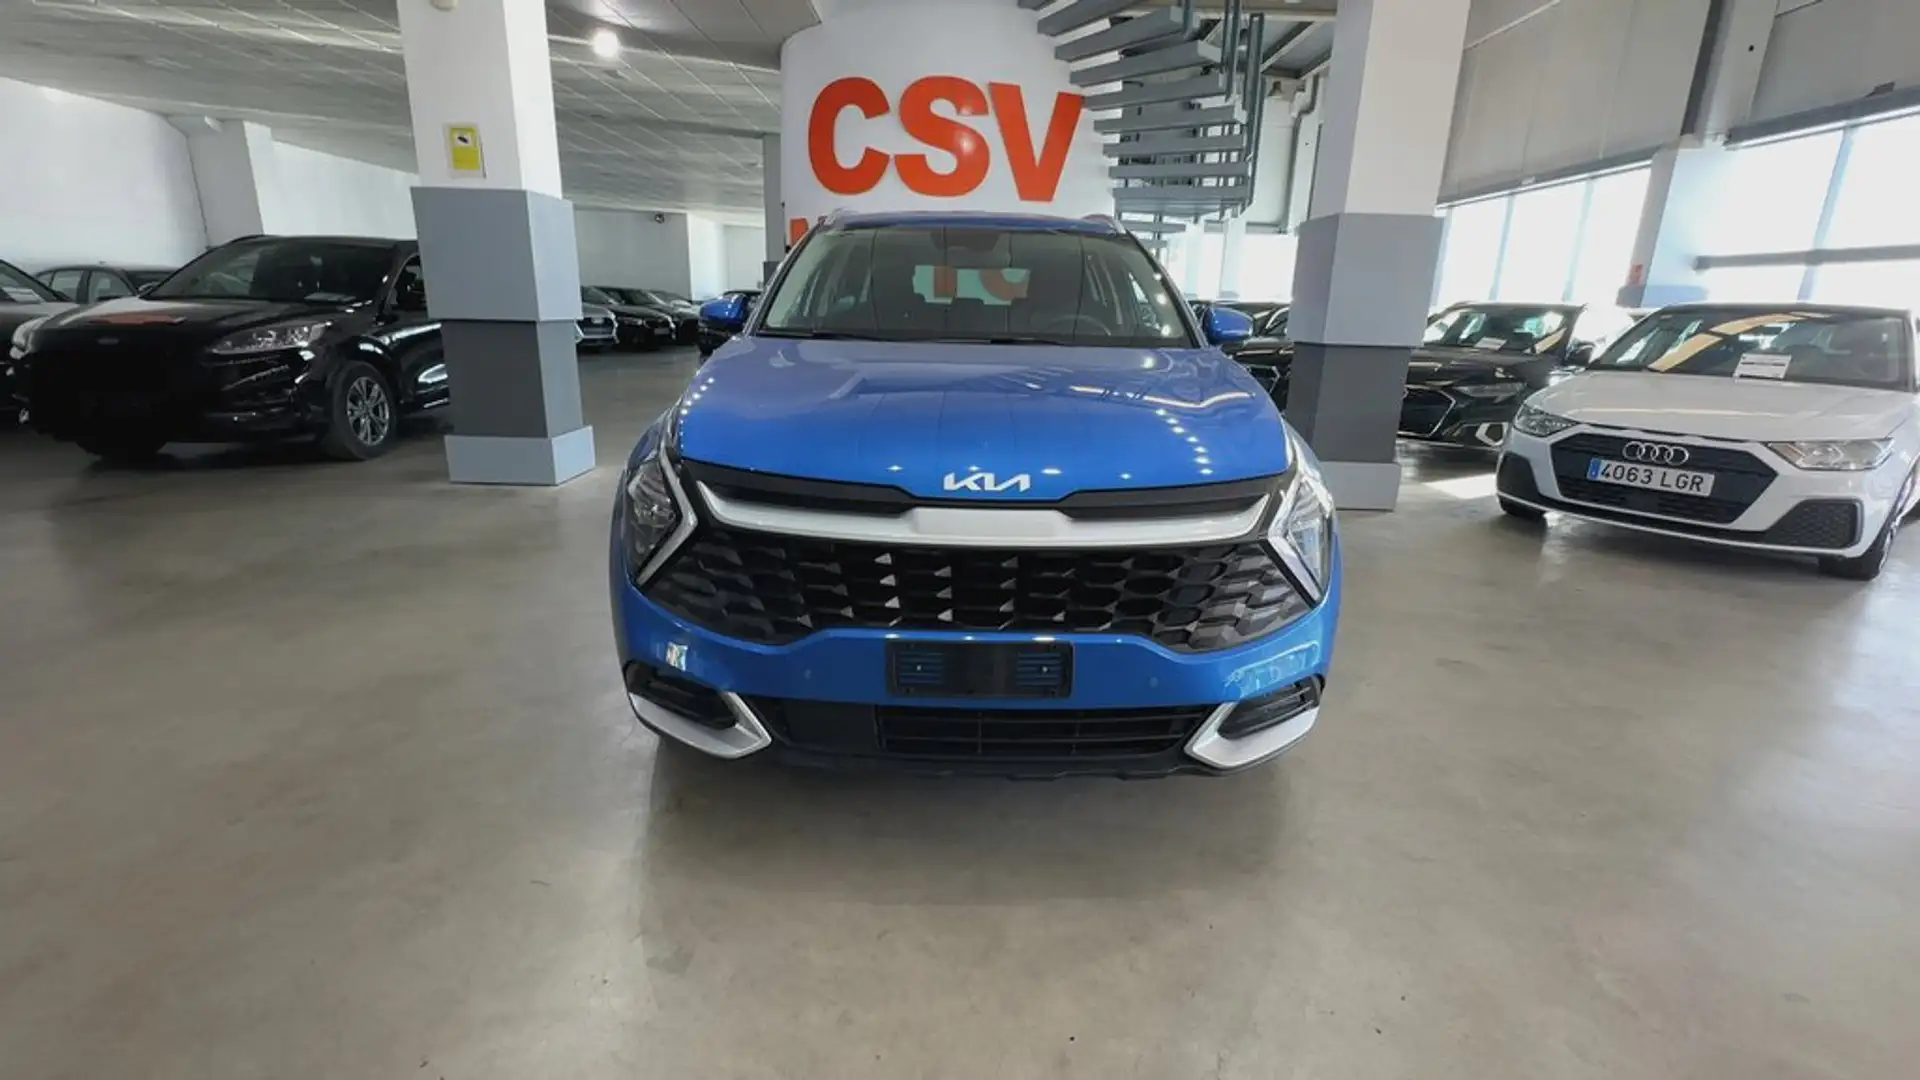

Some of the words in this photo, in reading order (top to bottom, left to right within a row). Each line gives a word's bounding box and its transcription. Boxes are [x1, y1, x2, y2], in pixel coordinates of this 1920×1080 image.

[808, 75, 1084, 203] CSV
[1601, 463, 1654, 485] 4063
[1660, 471, 1704, 492] LGR
